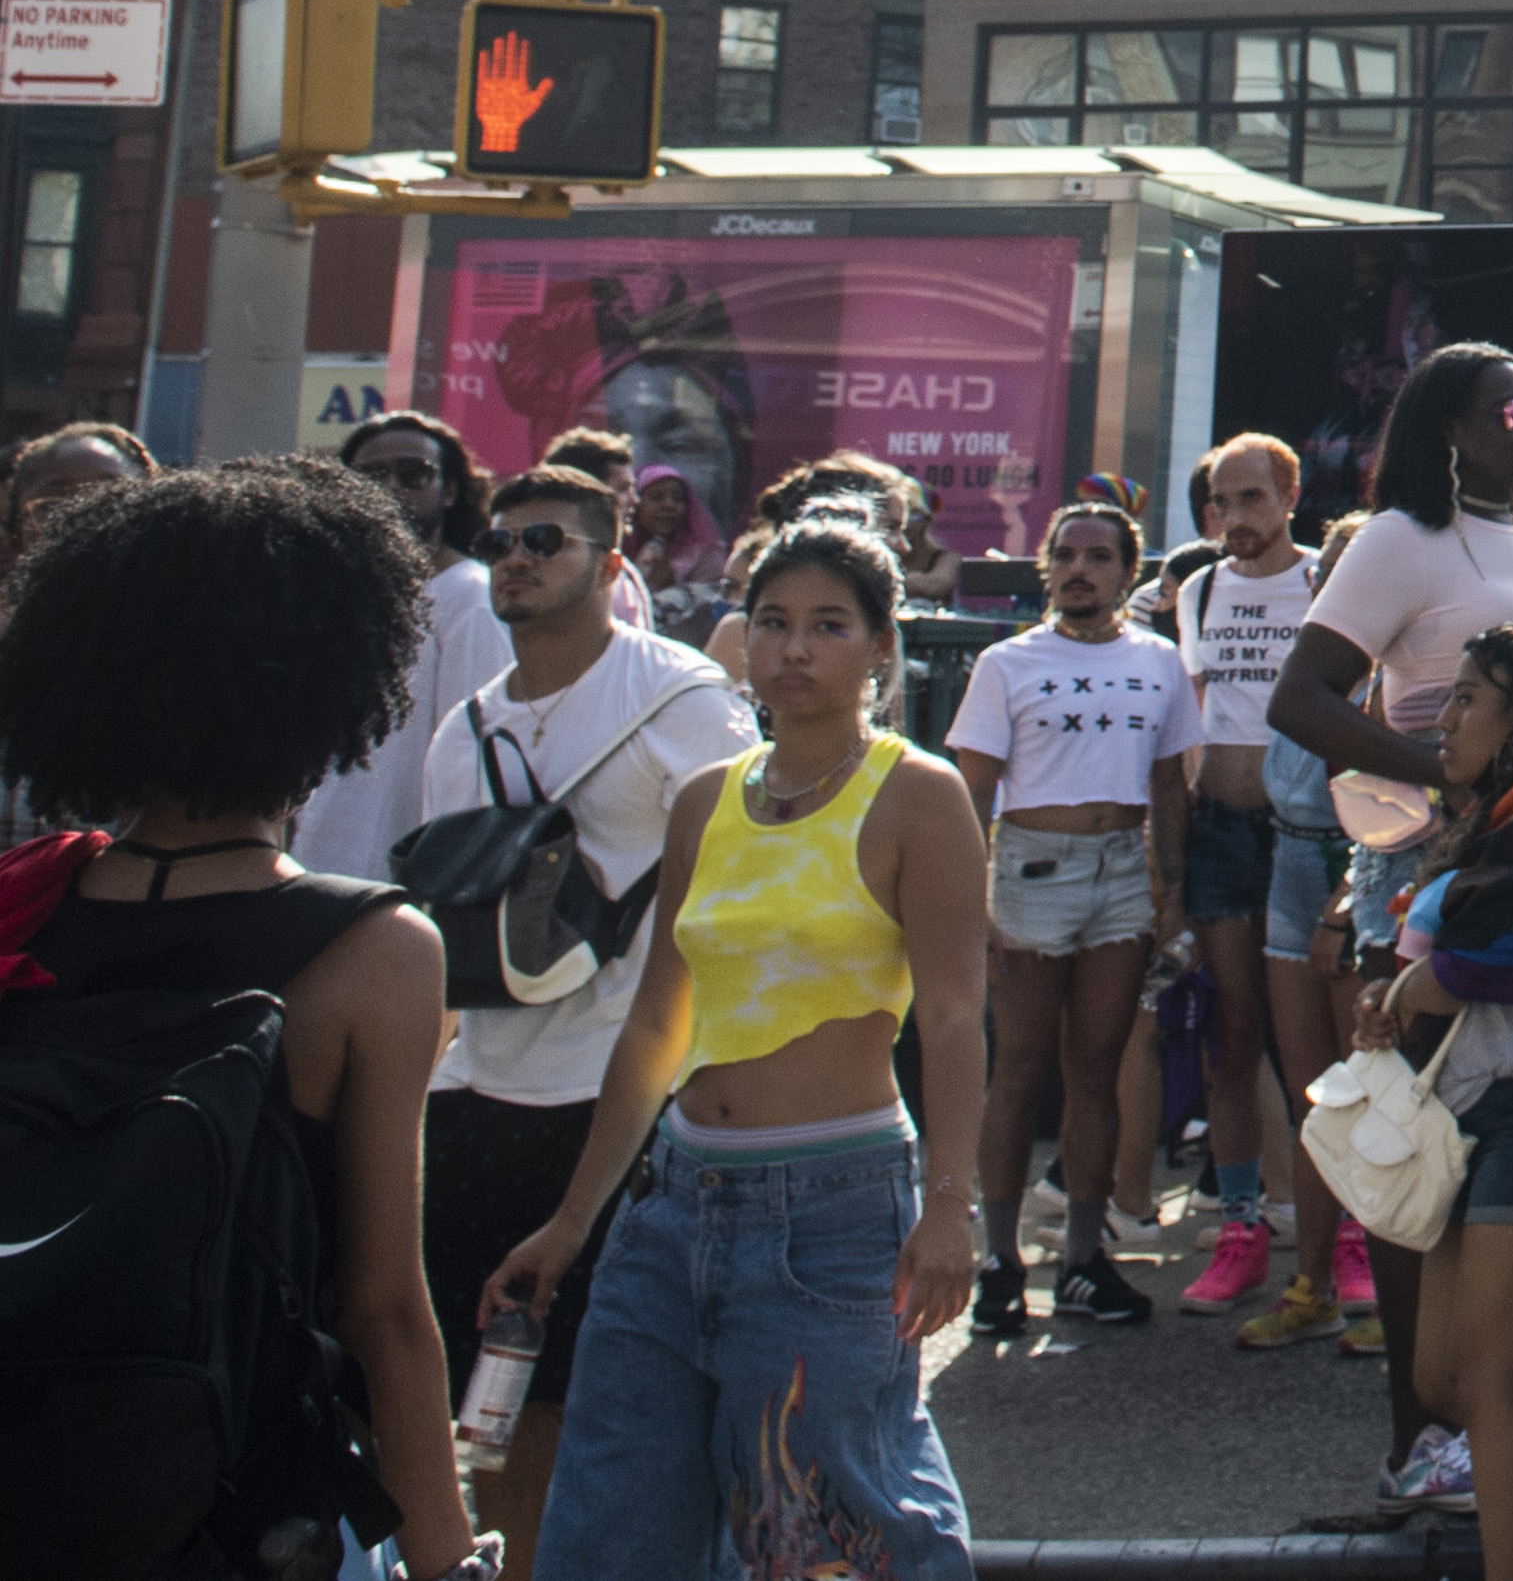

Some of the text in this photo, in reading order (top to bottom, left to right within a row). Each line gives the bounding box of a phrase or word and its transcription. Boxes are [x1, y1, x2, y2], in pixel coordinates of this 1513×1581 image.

[12, 6, 128, 27] NO PARKING
[12, 30, 90, 53] Anytime
[711, 214, 816, 236] JCDecaux
[887, 430, 943, 457] NEW
[1231, 605, 1268, 619] THE
[1219, 647, 1268, 661] IS MY
